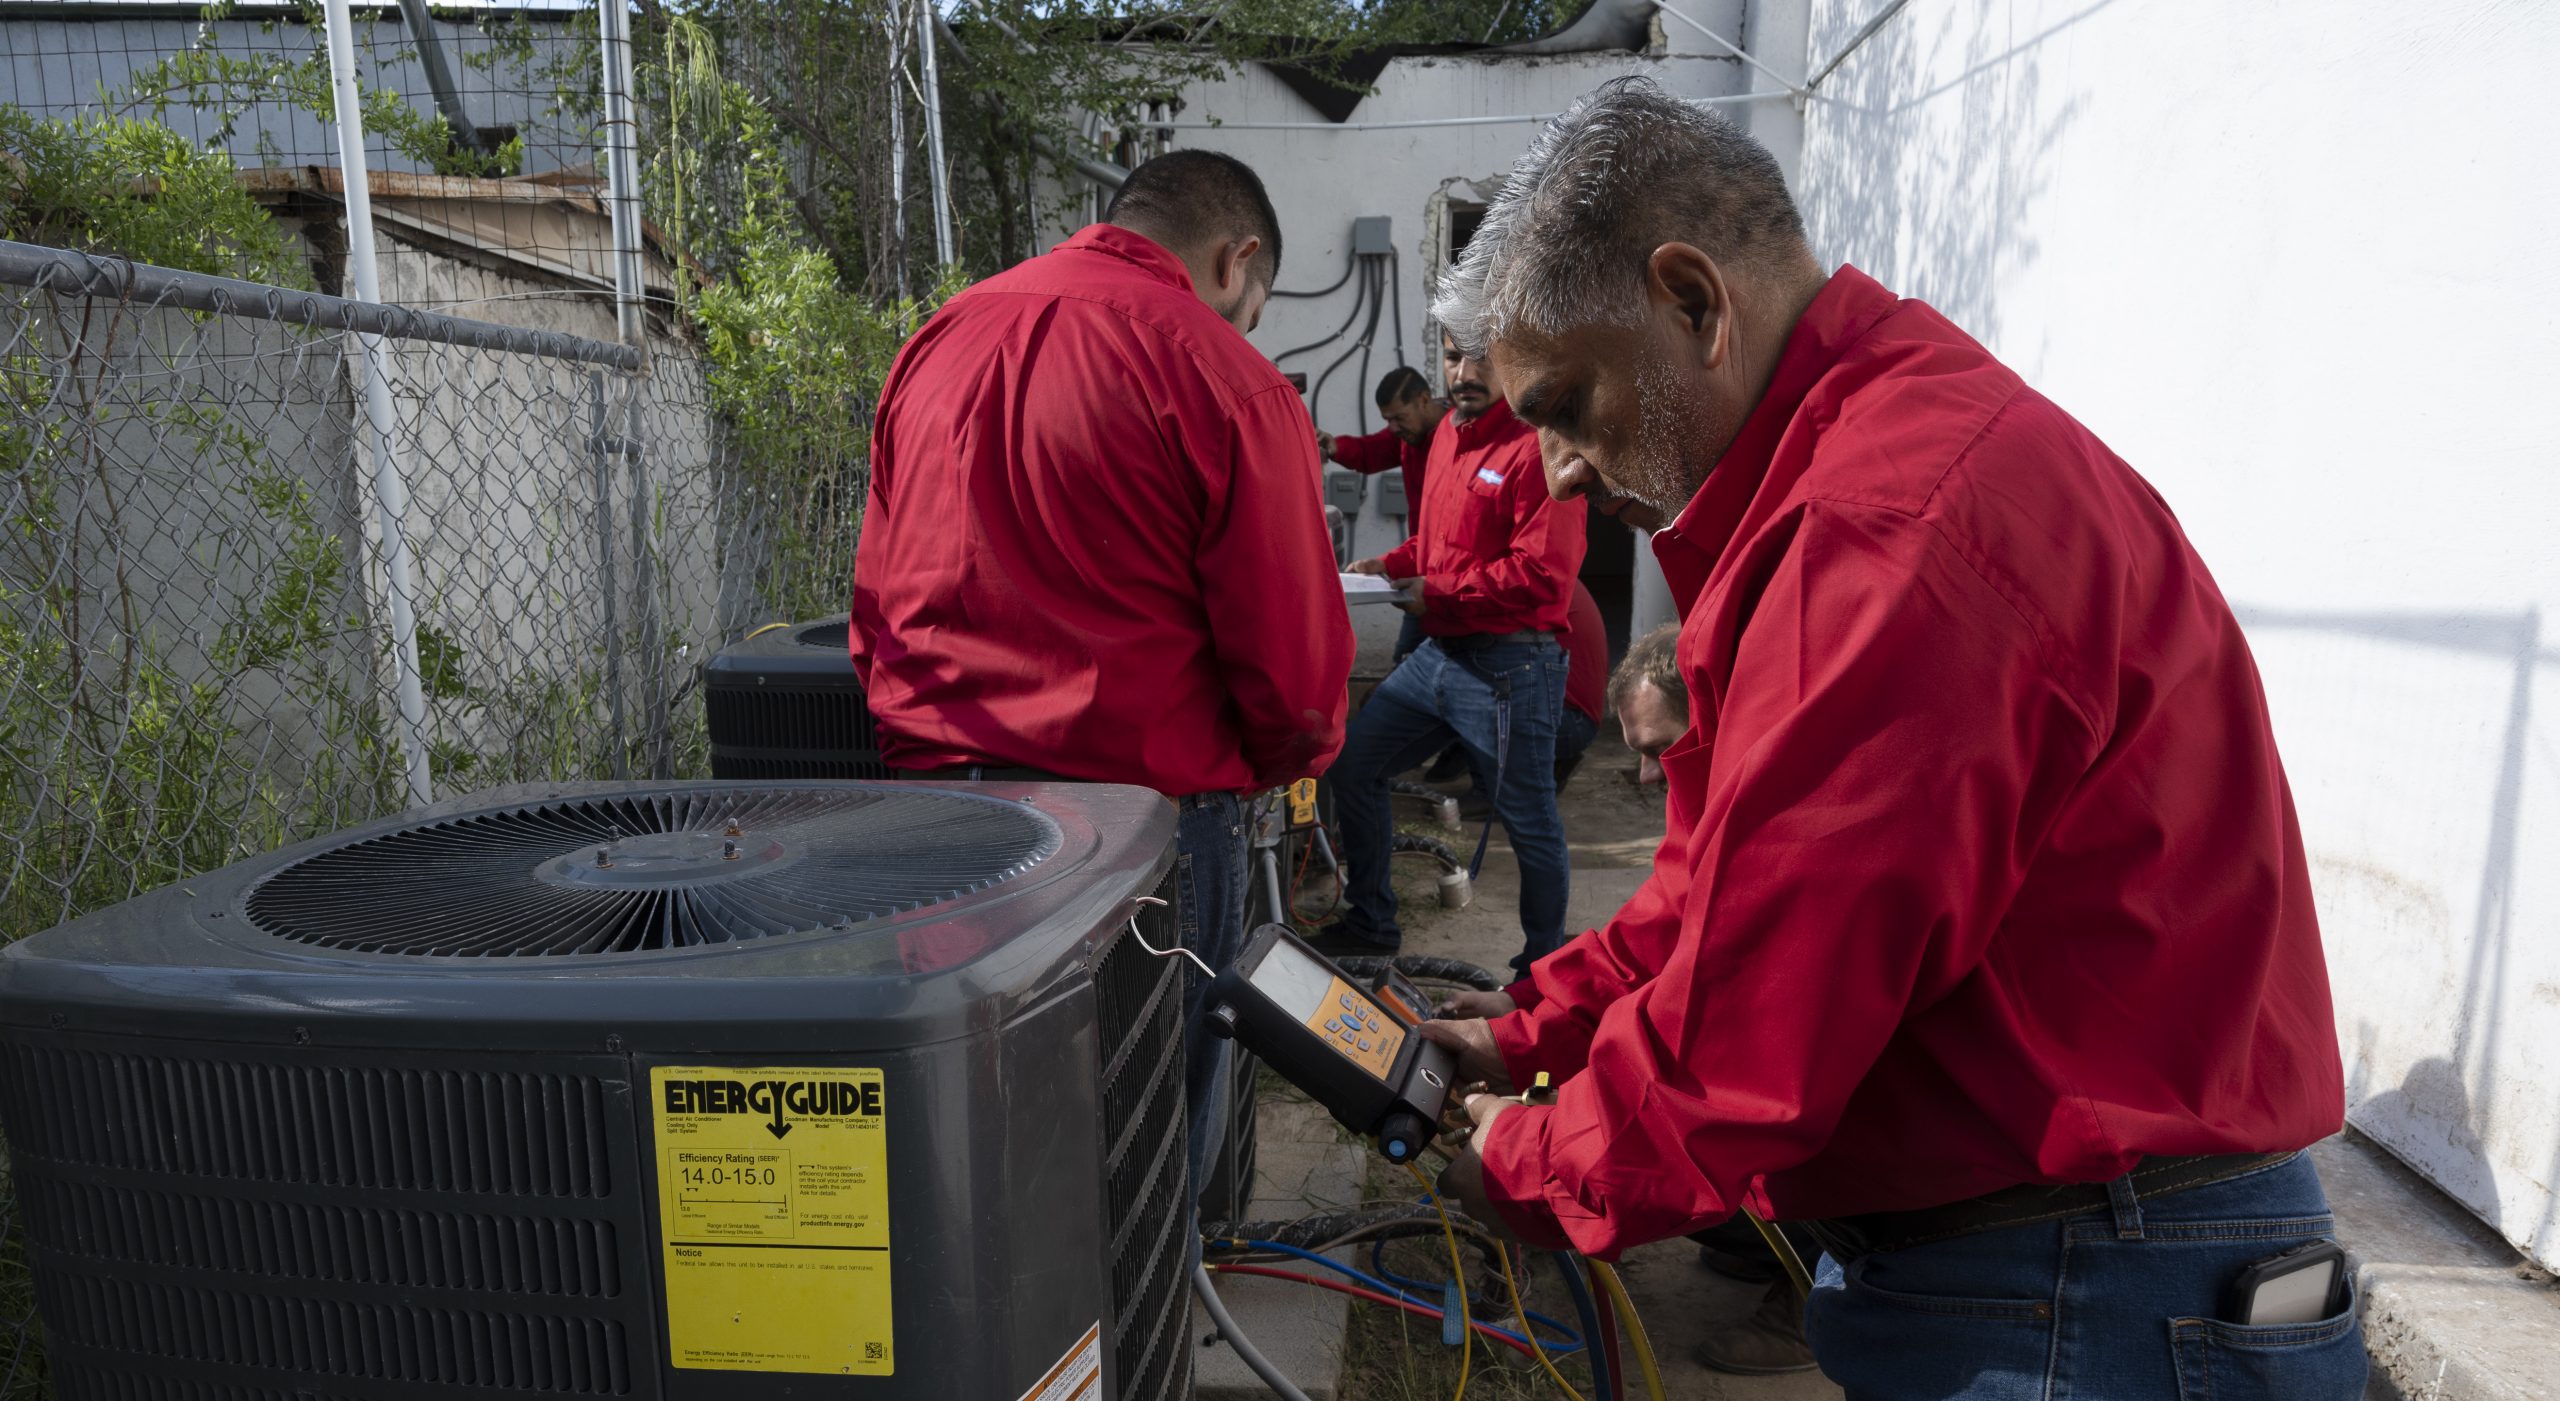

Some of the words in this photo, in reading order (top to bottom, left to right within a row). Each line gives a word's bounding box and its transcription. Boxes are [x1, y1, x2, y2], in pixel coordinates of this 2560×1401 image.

[664, 1081, 881, 1116] ENERGYGUIDE
[680, 1154, 723, 1164] Efficiency
[726, 1154, 754, 1165] Rating
[682, 1168, 775, 1185] 14.0-15.0
[676, 1248, 702, 1257] Notice
